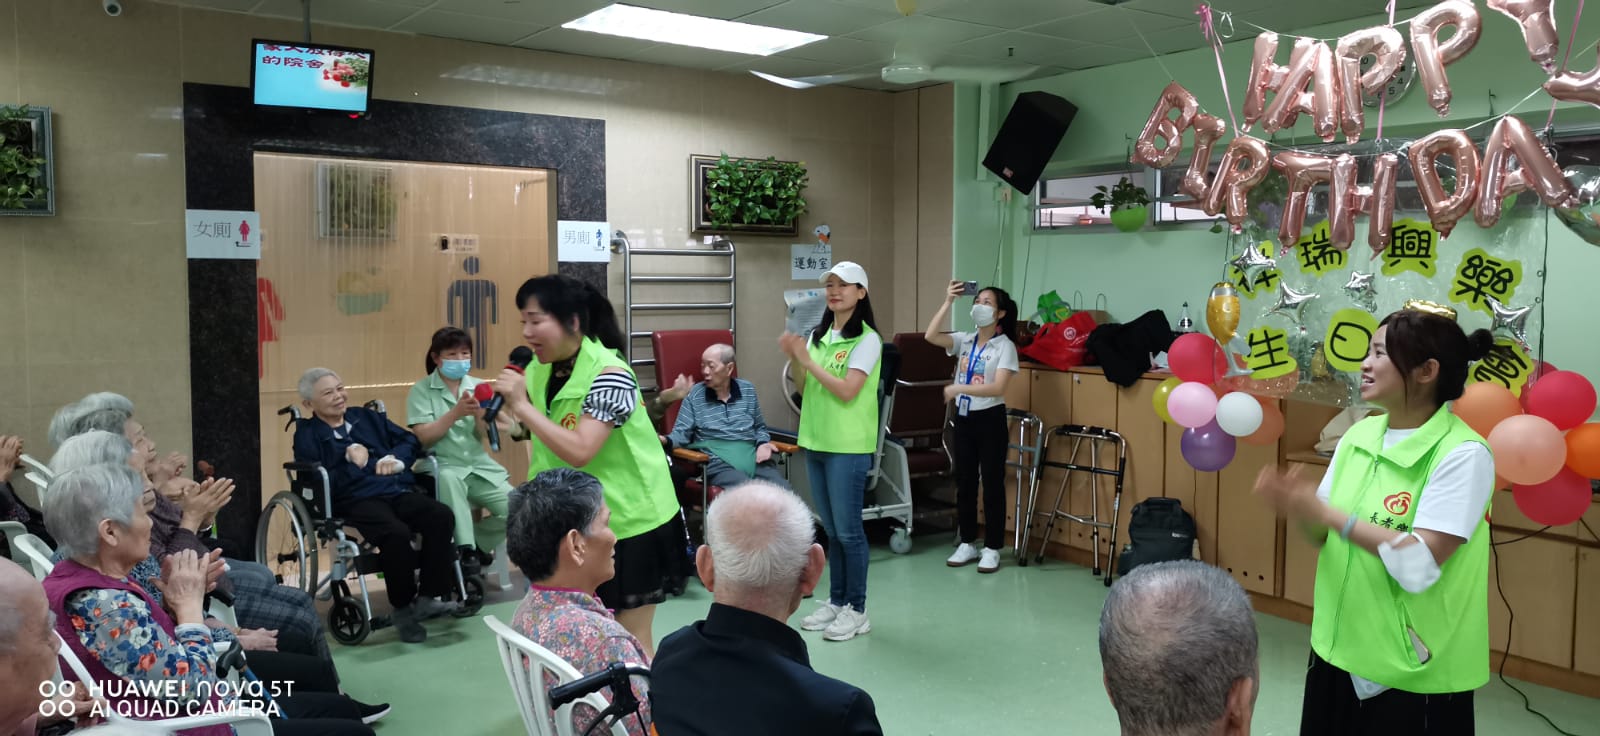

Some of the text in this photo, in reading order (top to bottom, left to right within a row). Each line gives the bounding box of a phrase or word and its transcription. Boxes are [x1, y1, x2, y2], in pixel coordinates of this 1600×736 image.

[1242, 0, 1559, 142] HAPPY
[1388, 86, 1395, 95] 5
[794, 255, 829, 270] 運動室
